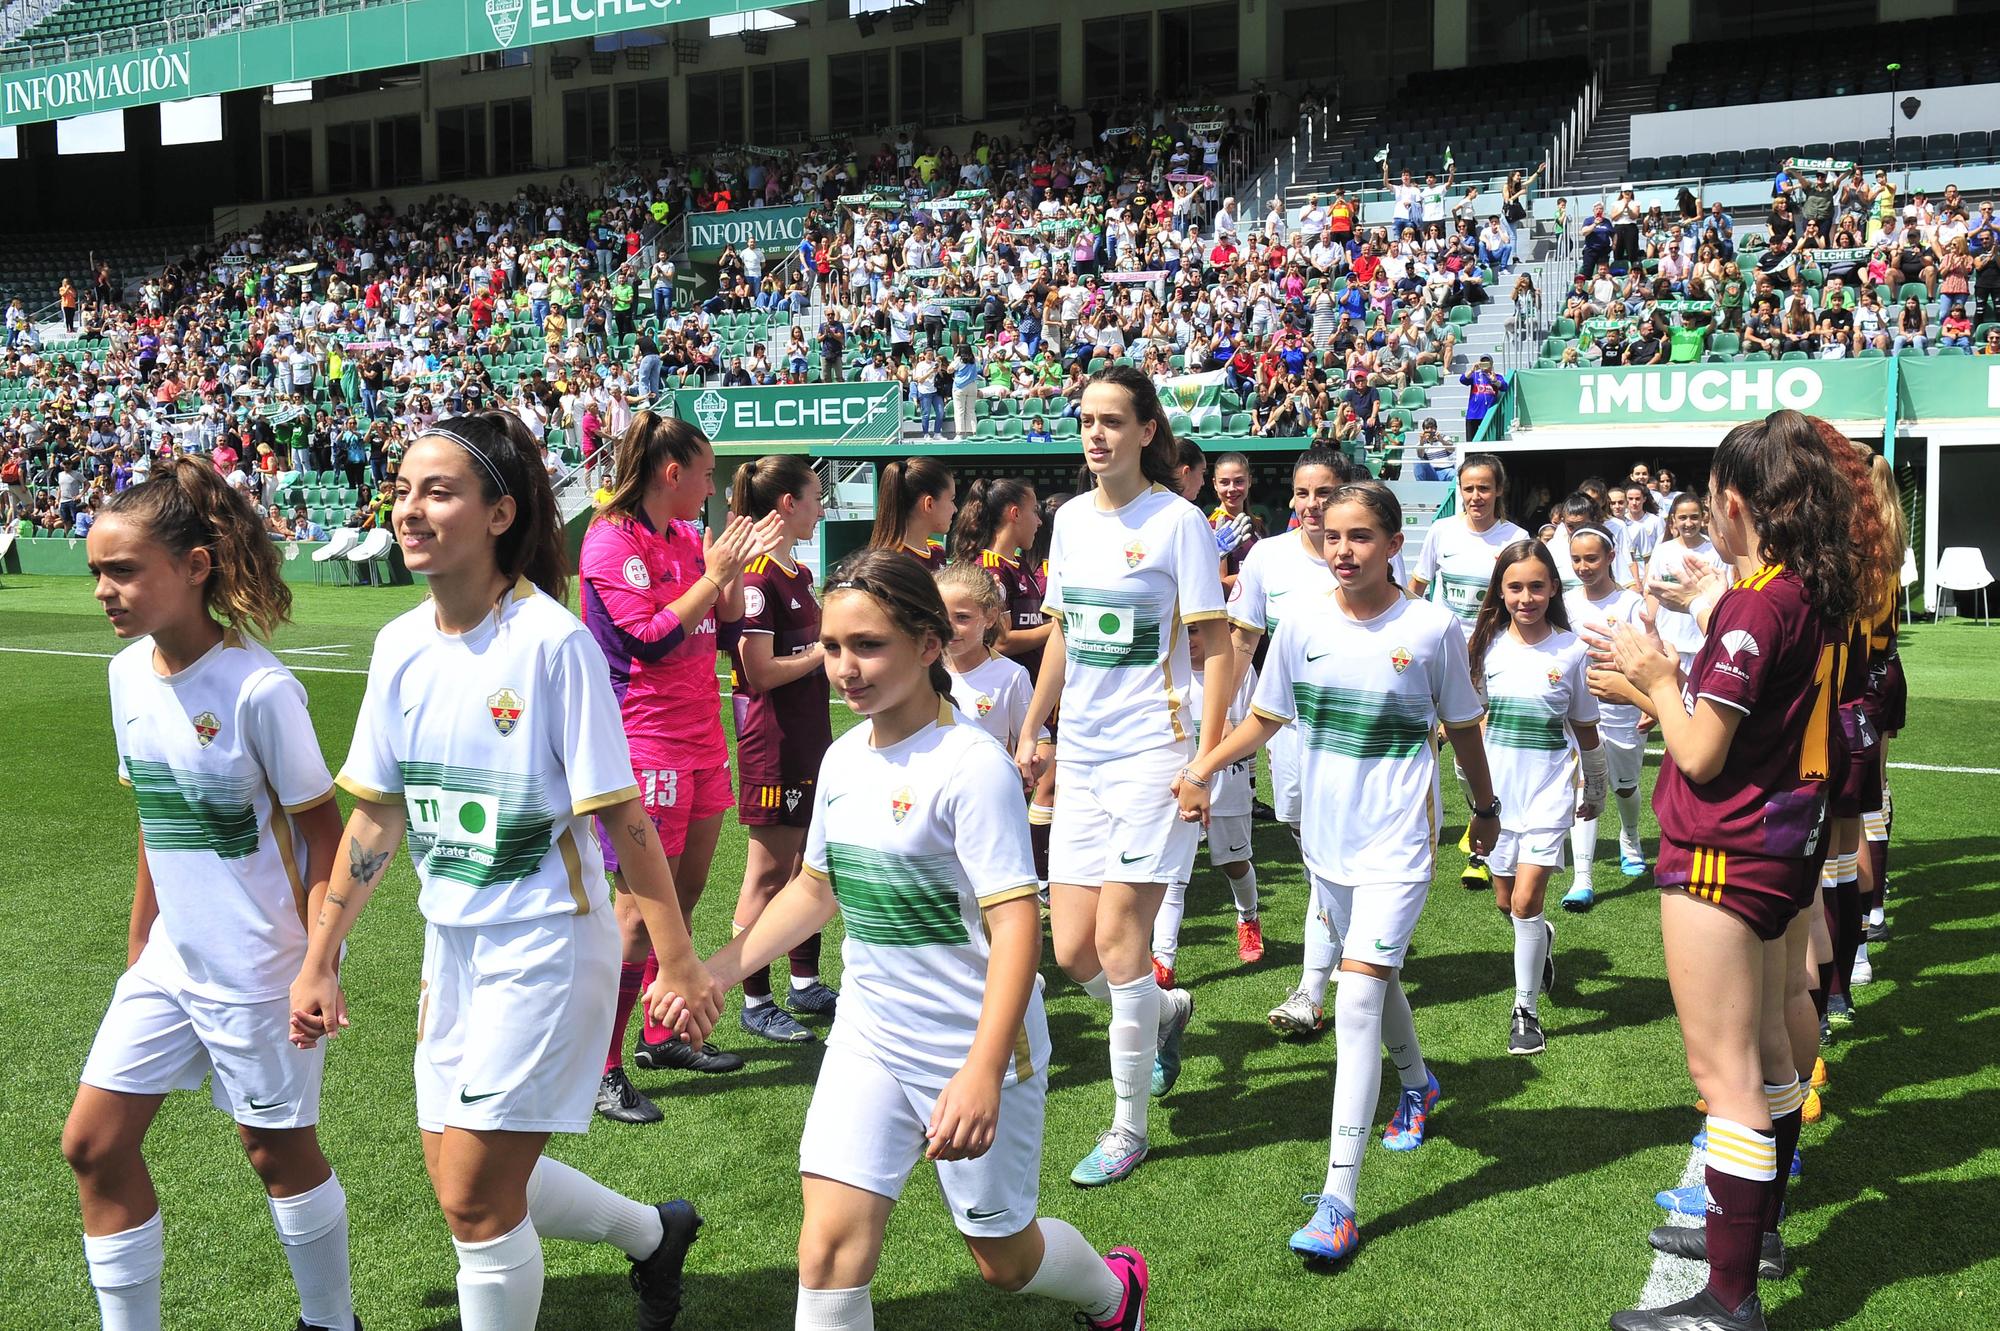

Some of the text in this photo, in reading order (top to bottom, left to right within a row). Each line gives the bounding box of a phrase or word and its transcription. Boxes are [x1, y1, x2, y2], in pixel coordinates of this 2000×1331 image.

[5, 48, 191, 114] INFORMACIÓN
[1797, 159, 1850, 169] ELCHE CF
[477, 217, 488, 226] 24
[1813, 249, 1871, 260] ELCHE CF
[1692, 300, 1706, 311] CF
[1579, 367, 1823, 414] ¡MUCHO
[734, 397, 888, 428] ELCHECF
[641, 769, 678, 808] 13
[434, 846, 465, 858] state
[656, 1043, 673, 1052] COPA
[1391, 1045, 1407, 1054] CF
[1338, 1125, 1366, 1138] ECF
